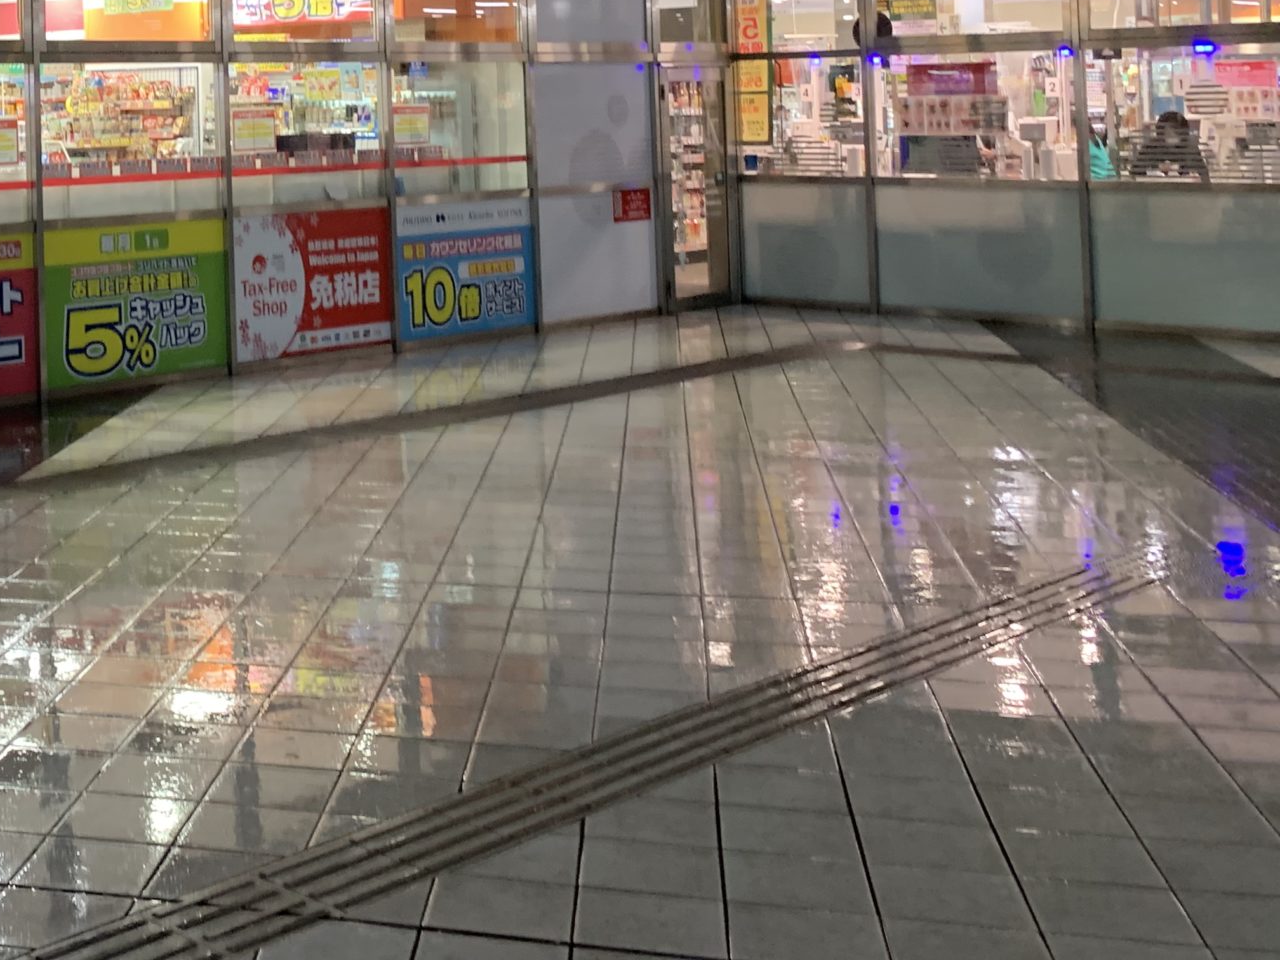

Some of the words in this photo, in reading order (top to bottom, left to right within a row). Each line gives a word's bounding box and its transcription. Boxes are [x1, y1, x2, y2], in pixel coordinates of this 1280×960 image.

[241, 277, 298, 298] Tax-Free
[309, 269, 381, 312] 免税店
[129, 293, 206, 324] キャッシュ
[252, 298, 288, 318] Shop
[63, 301, 158, 380] 5%
[159, 318, 207, 351] バック
